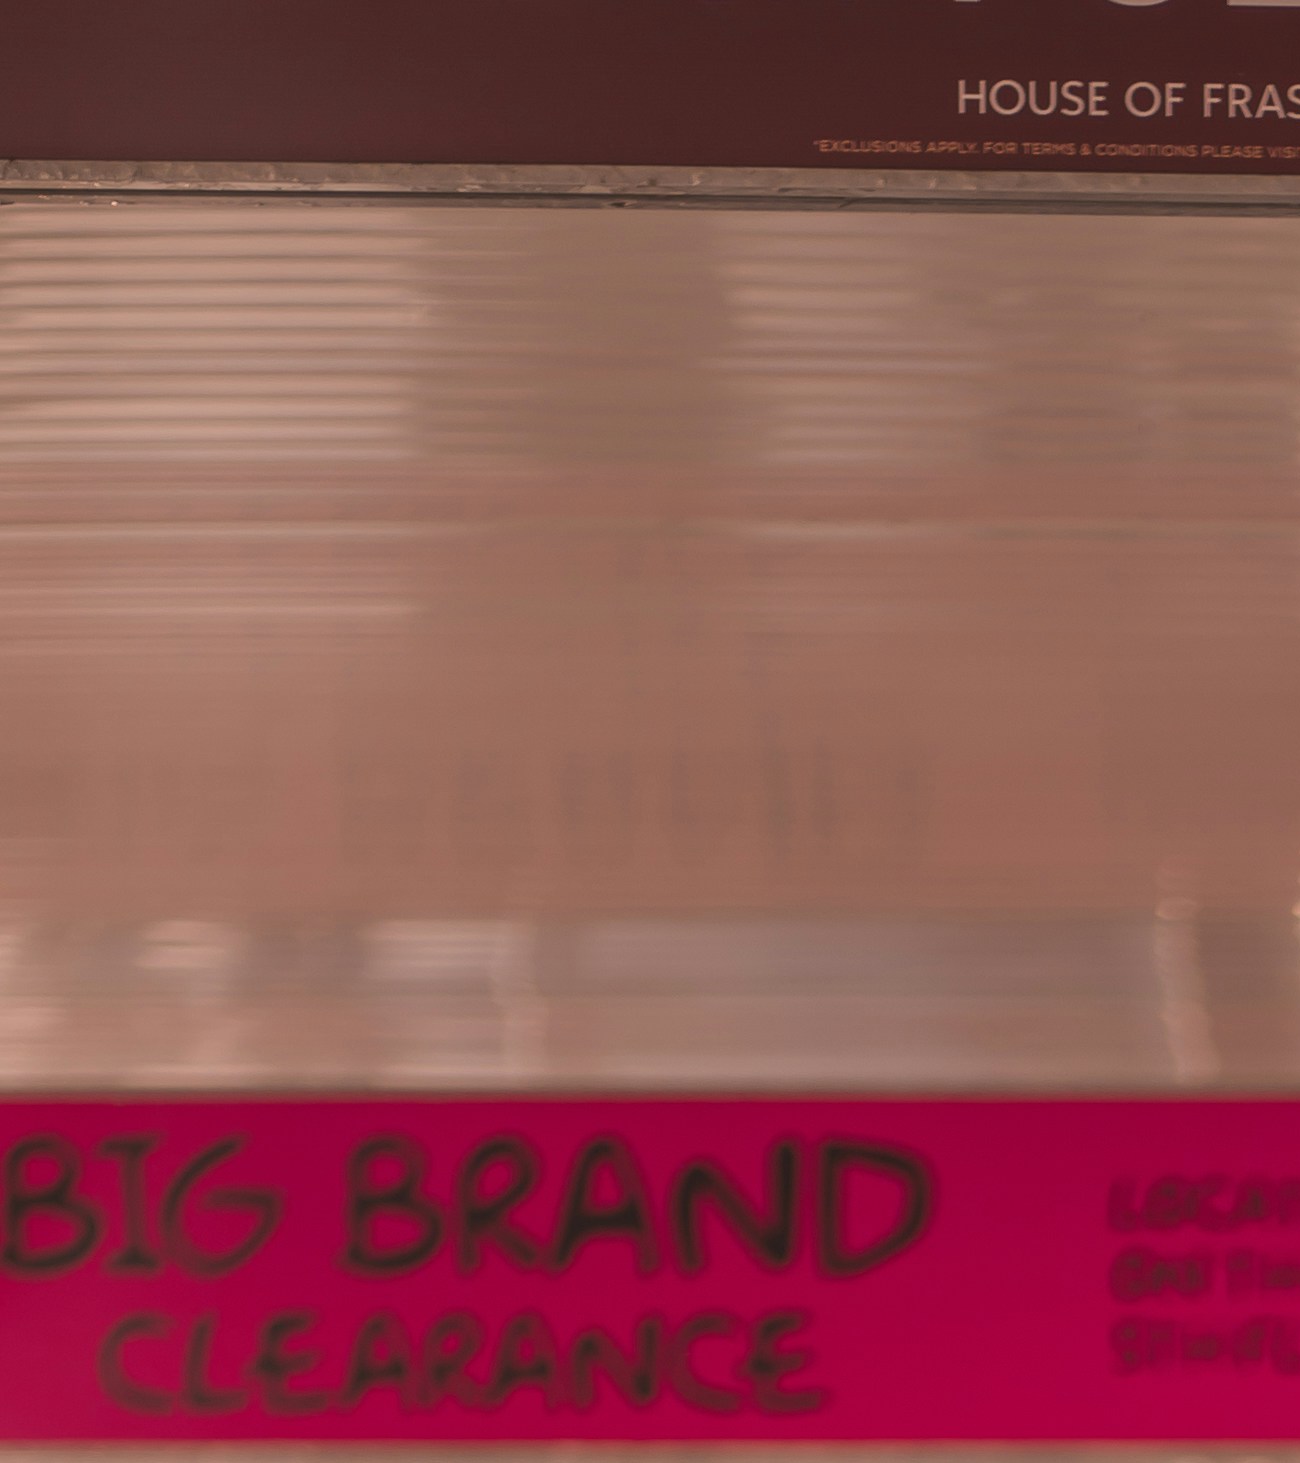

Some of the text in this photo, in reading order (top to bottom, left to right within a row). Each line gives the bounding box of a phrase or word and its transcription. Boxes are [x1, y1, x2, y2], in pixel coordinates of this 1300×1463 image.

[957, 79, 1109, 117] HOUSE
[1124, 81, 1187, 118] OF
[982, 142, 1016, 154] FOR
[1022, 142, 1075, 155] TERMS
[1095, 143, 1198, 158] CONDITIONS
[1201, 145, 1264, 158] PLEASE
[0, 1131, 935, 1280] BIG BRAND
[98, 1309, 830, 1416] CLEARANCE
